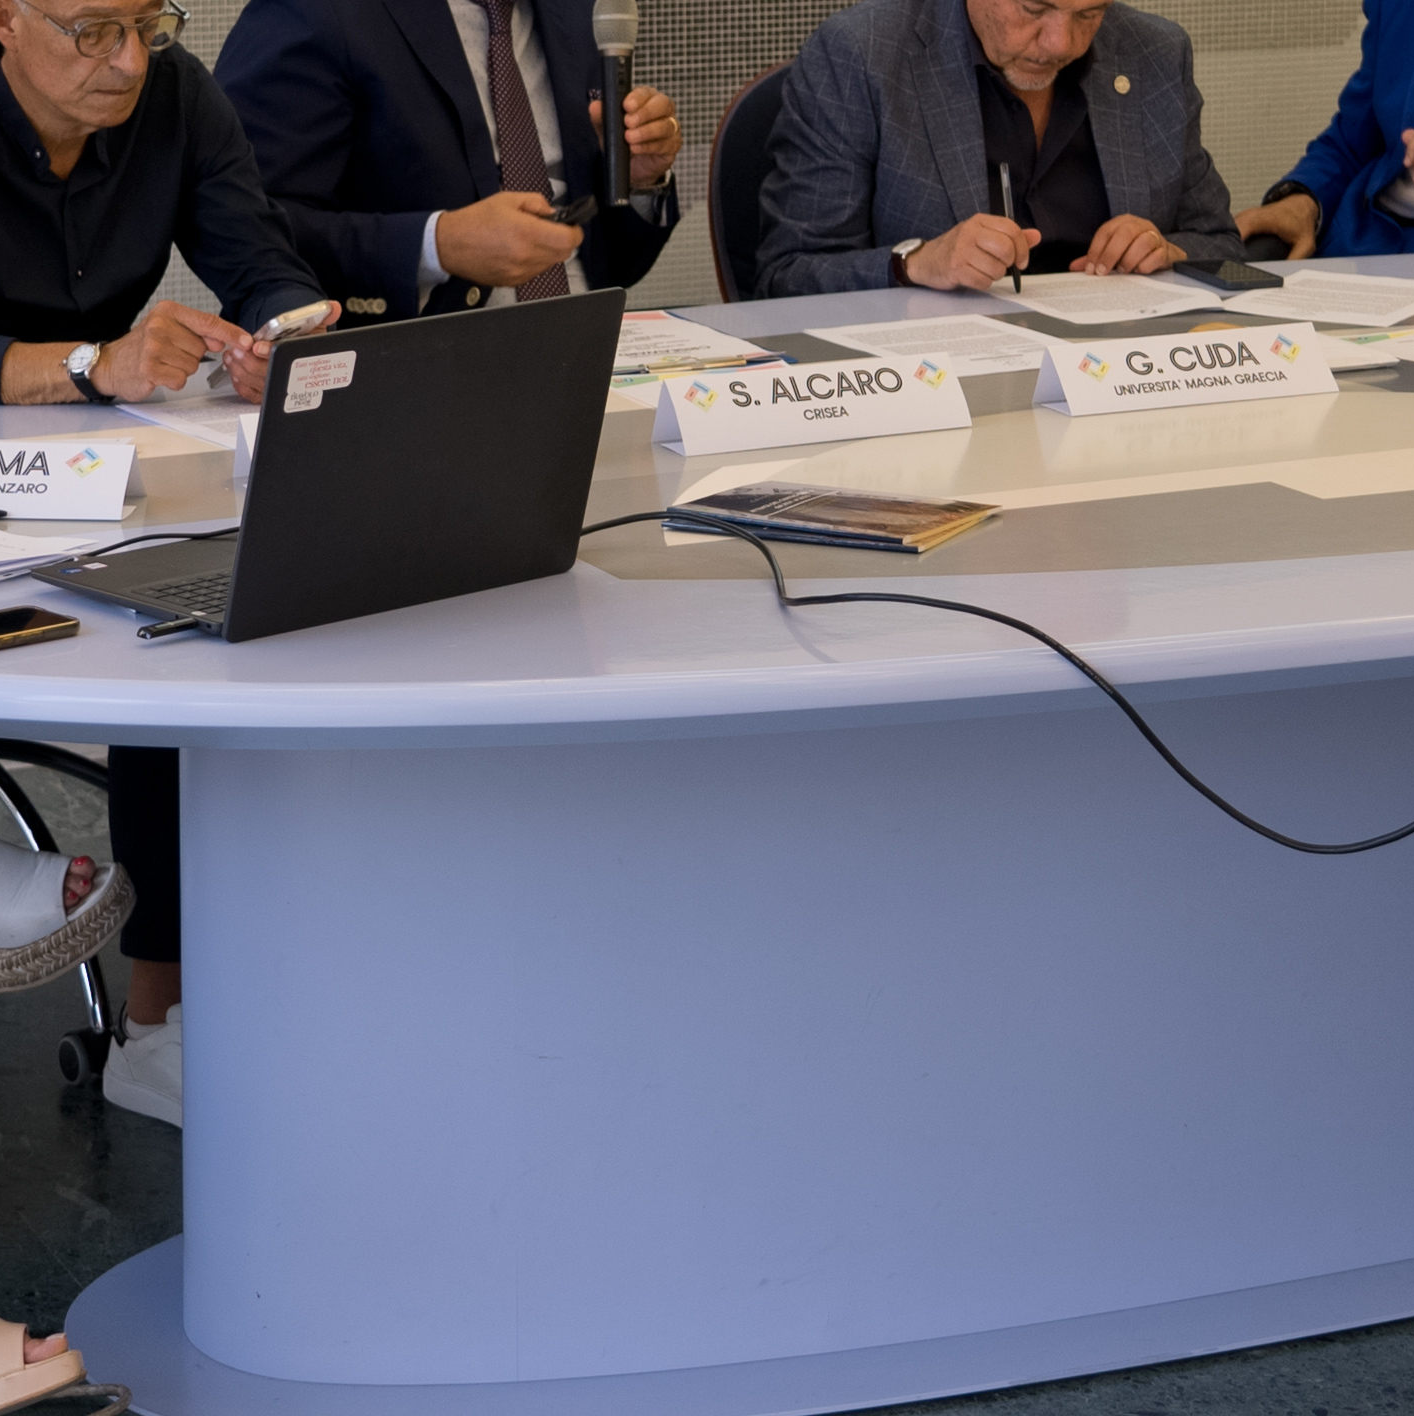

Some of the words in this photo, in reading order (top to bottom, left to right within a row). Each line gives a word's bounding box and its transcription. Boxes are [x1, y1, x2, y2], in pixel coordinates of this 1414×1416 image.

[1126, 351, 1163, 375] G.
[1169, 342, 1260, 371] CUDA
[729, 381, 761, 407] S.
[772, 368, 902, 404] ALCARO
[1185, 376, 1232, 389] MAGNA
[1234, 371, 1287, 384] GRAECIA
[804, 406, 849, 420] CRISEA
